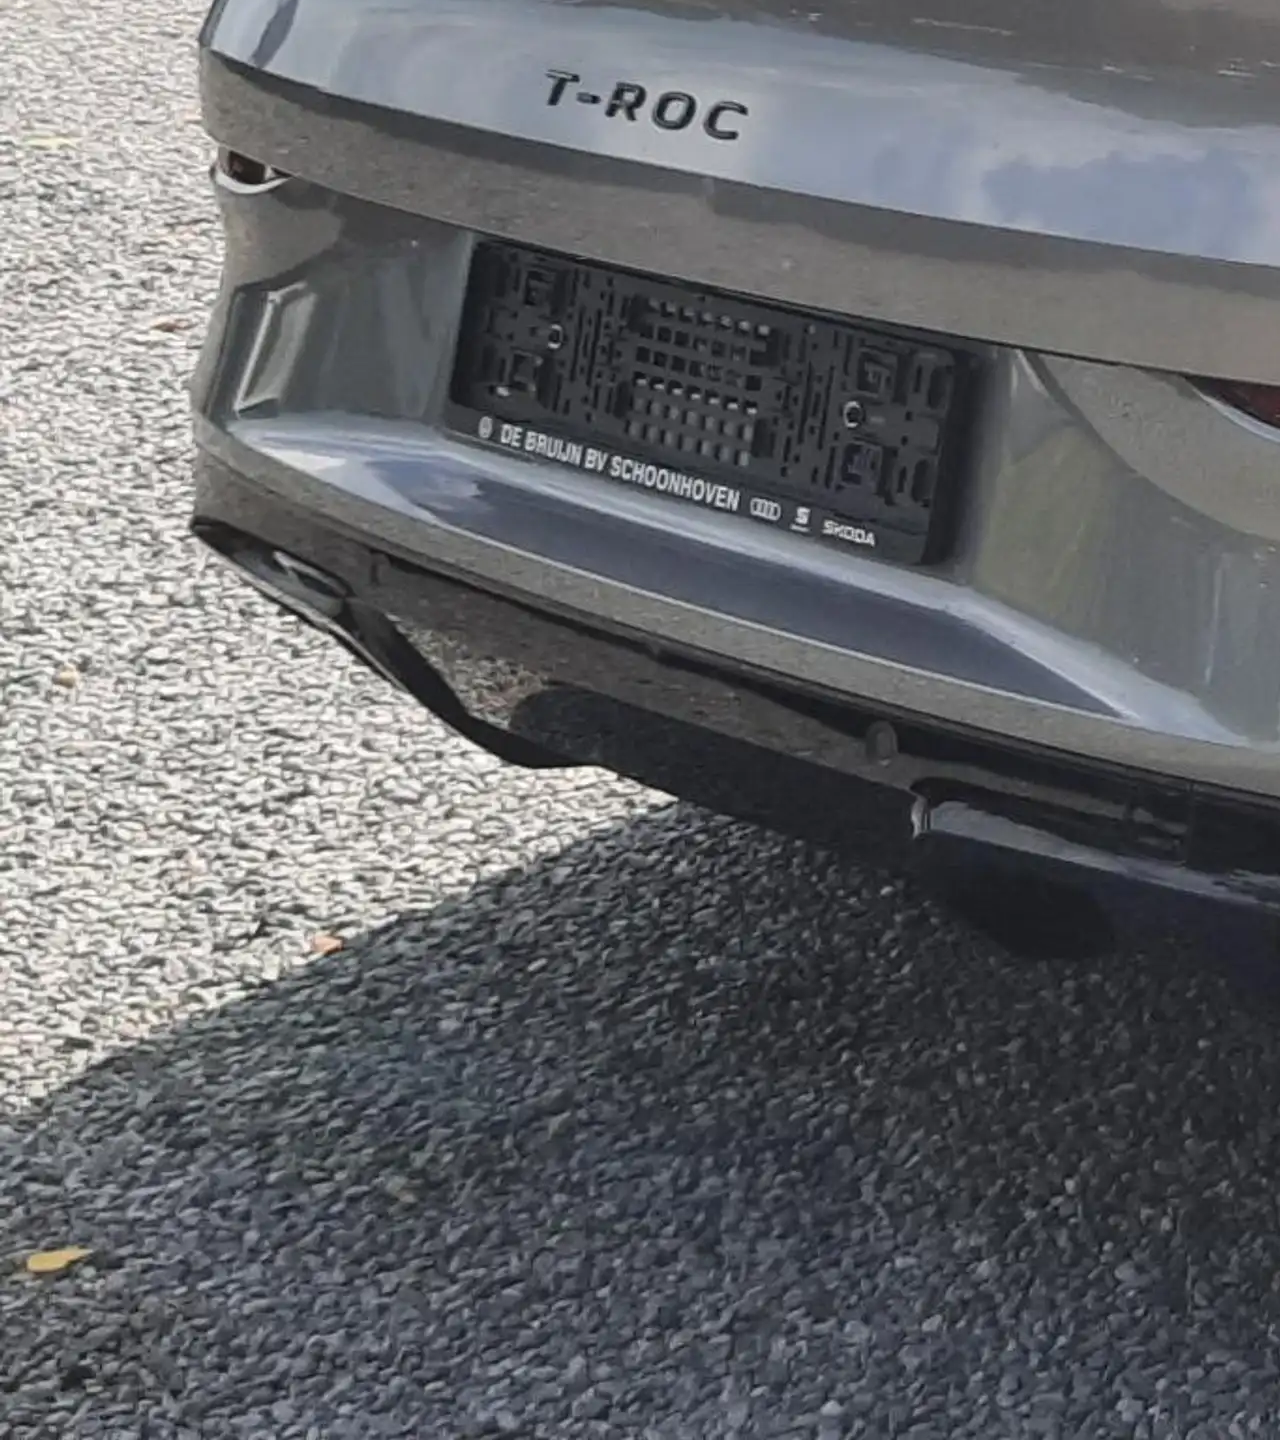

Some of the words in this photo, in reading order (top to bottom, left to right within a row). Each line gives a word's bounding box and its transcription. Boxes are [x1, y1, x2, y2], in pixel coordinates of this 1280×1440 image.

[545, 68, 749, 140] T-ROC
[500, 423, 523, 447] DE
[524, 429, 583, 465] BRUIJN
[584, 447, 608, 472] BV
[609, 455, 741, 511] SCHOONHOVEN
